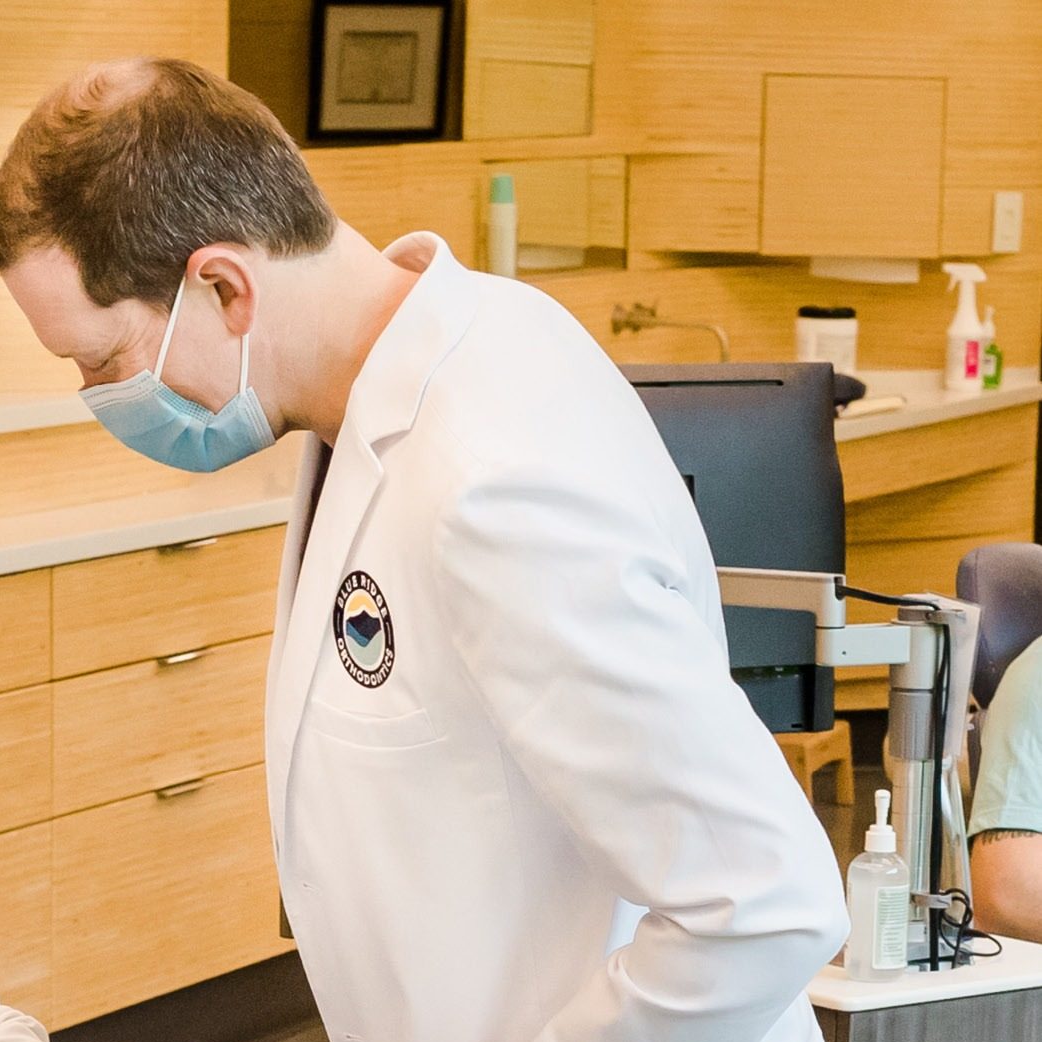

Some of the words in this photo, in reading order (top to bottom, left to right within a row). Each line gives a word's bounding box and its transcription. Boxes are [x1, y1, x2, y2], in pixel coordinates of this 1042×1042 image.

[338, 575, 359, 609] BLUE
[360, 575, 388, 619] RIDGE
[338, 637, 394, 687] ORTHODONTICS
